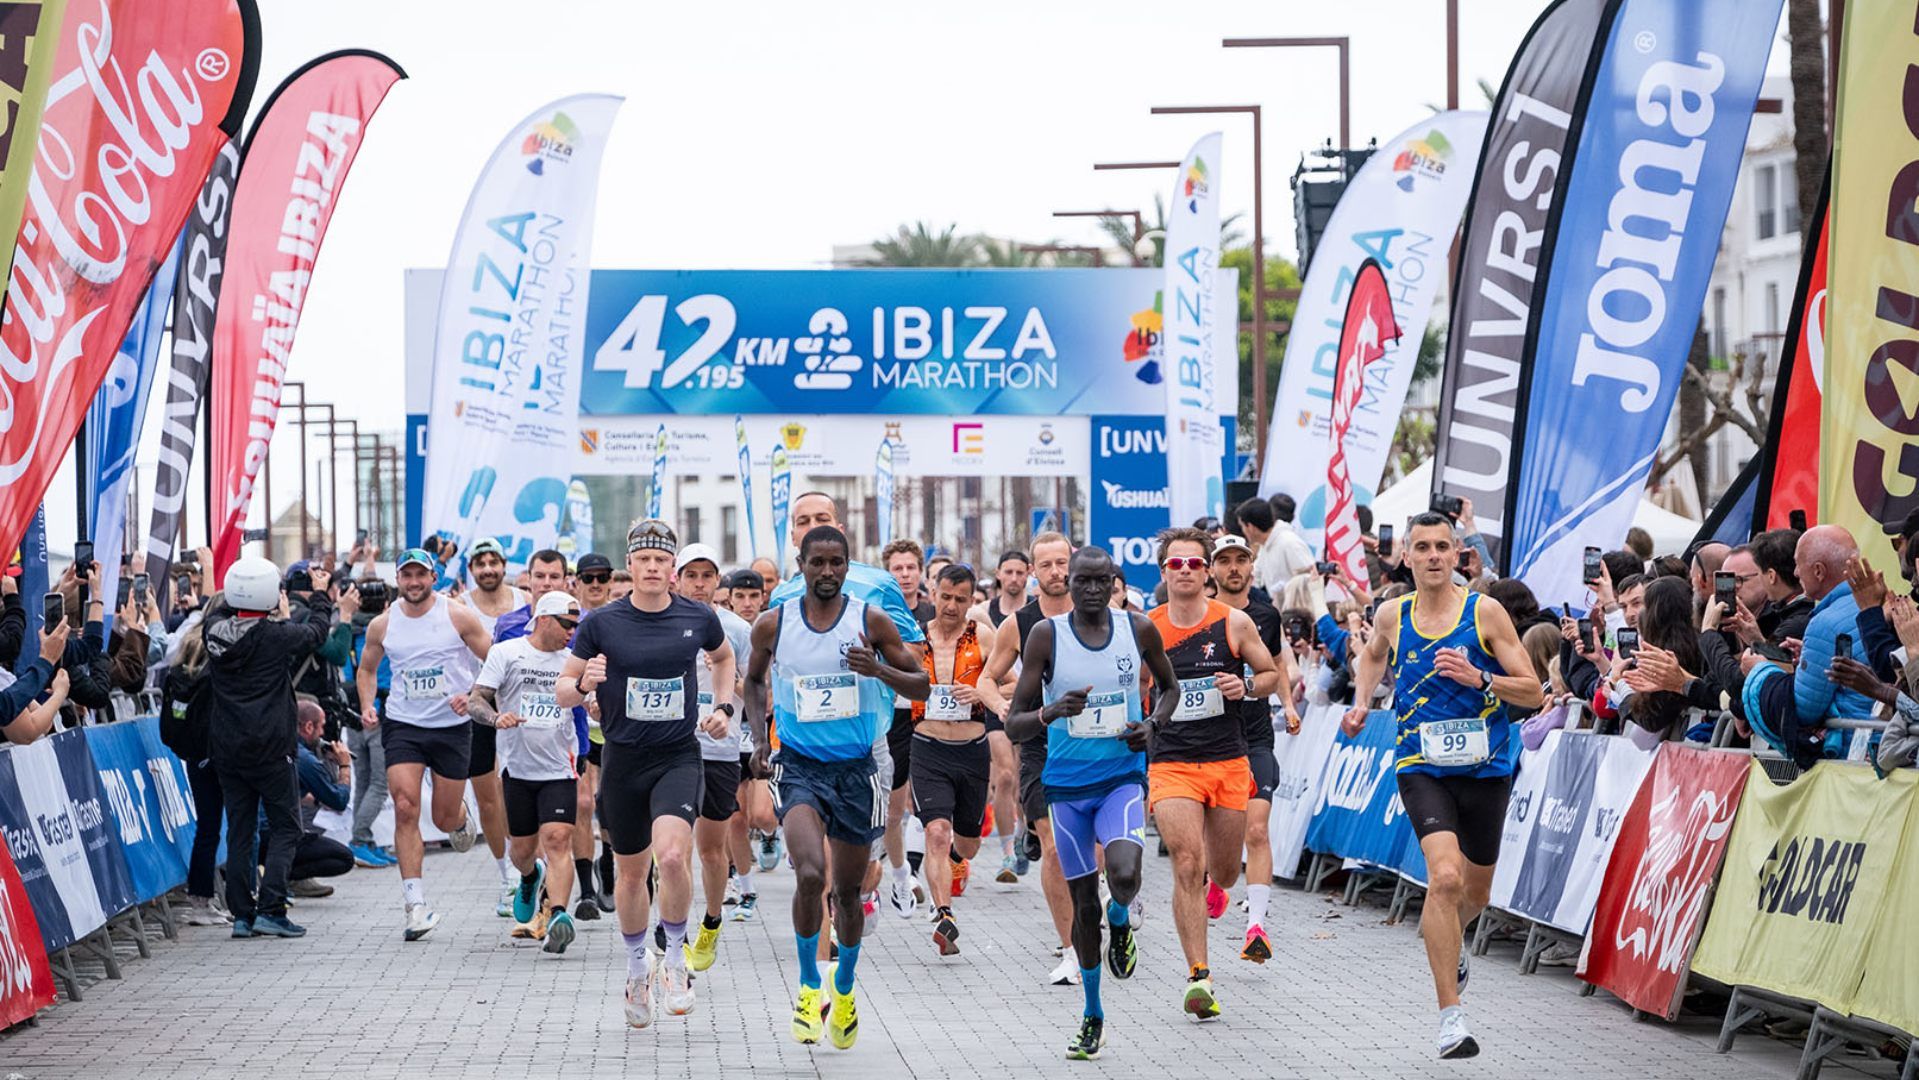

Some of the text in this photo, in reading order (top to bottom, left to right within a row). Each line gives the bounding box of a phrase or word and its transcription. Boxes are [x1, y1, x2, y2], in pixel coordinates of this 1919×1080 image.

[278, 111, 361, 273] IBIZA
[459, 211, 537, 391] IBIZA
[499, 213, 564, 398] MARATHON
[872, 306, 1057, 360] IBIZA
[1177, 246, 1201, 408] IBIZA
[593, 294, 738, 389] 42
[734, 337, 790, 366] KM
[872, 361, 1058, 390] MARATHON
[413, 677, 437, 690] 110
[642, 693, 672, 708] 131
[820, 689, 832, 706] 2
[940, 696, 957, 710] 95
[1184, 692, 1205, 708] 89
[528, 704, 561, 719] 1078
[1093, 708, 1102, 724] 1
[1443, 734, 1467, 752] 99
[1757, 836, 1866, 925] GOLDCAR
